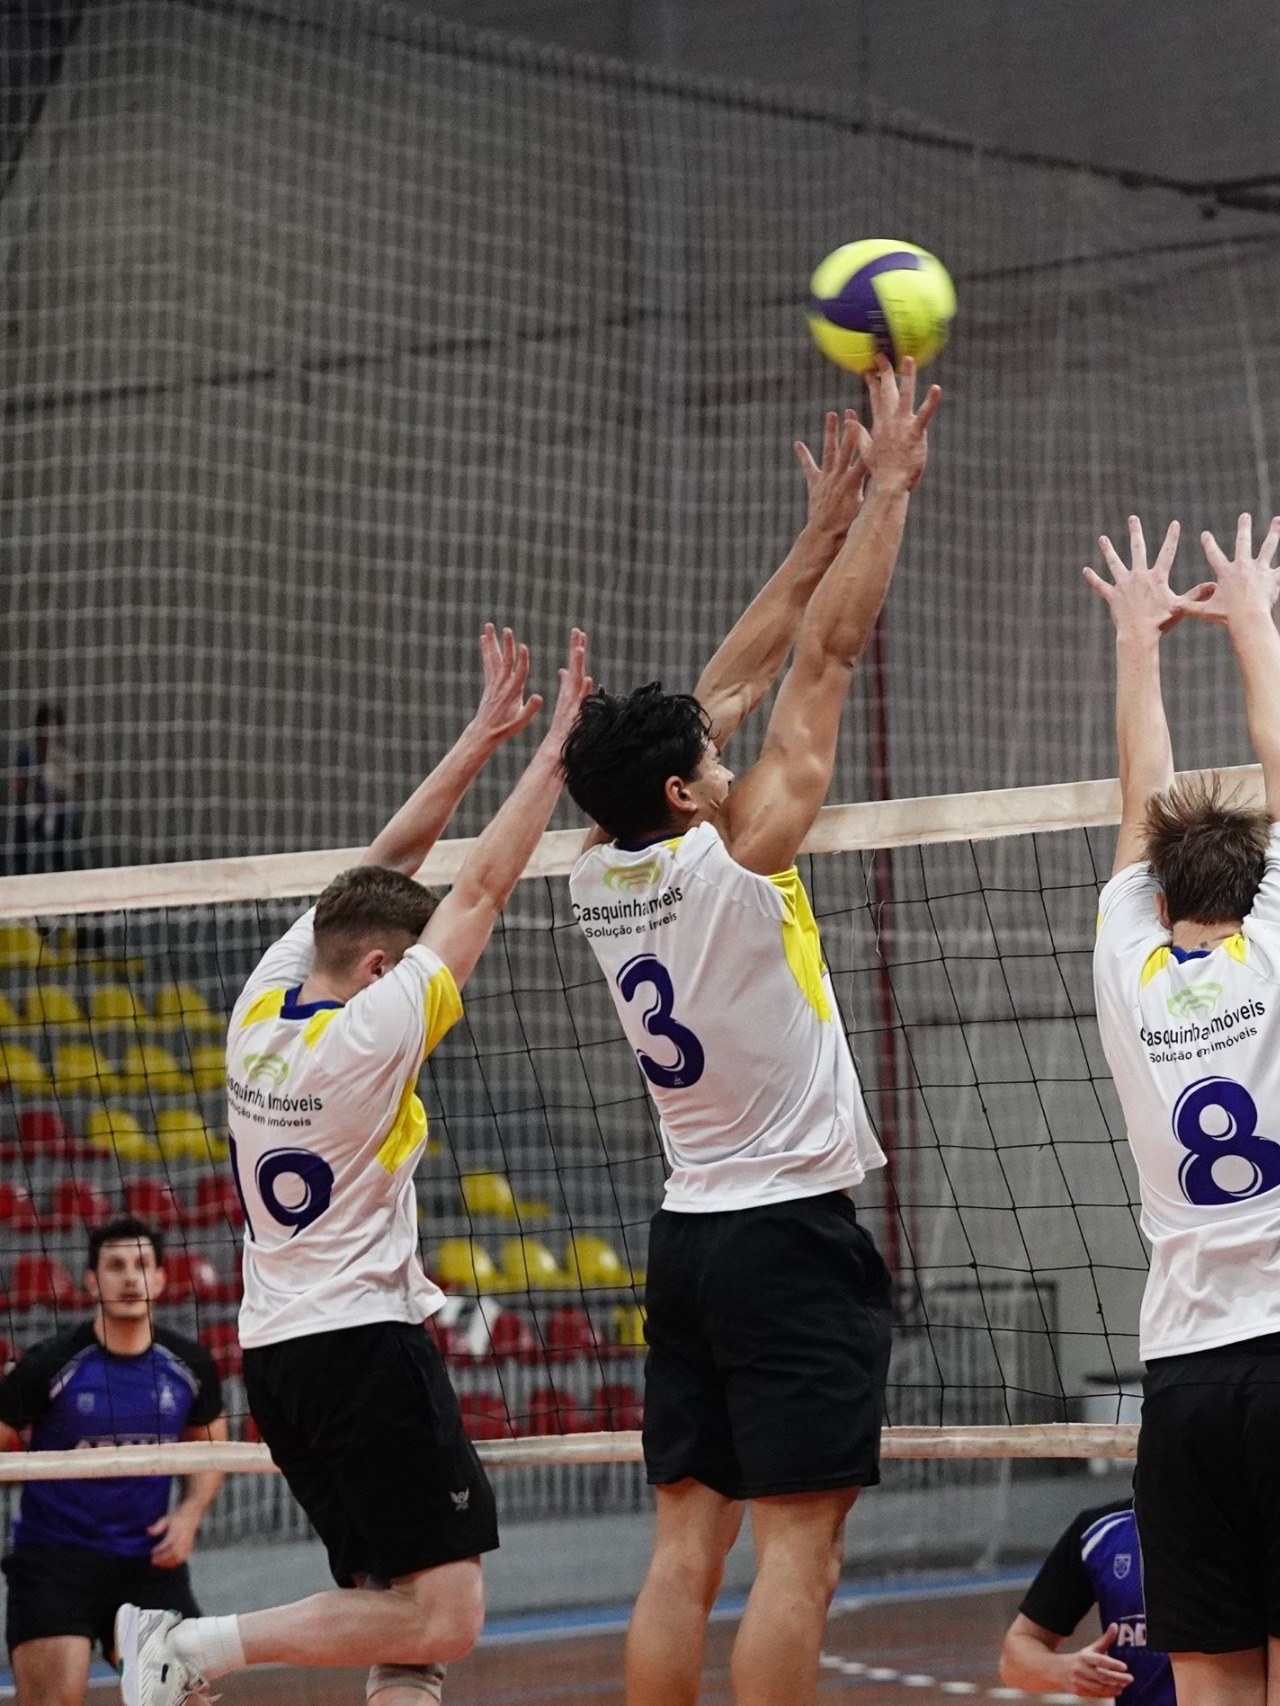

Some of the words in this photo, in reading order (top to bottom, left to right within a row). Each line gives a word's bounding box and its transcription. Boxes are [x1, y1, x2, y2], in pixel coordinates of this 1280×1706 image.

[616, 953, 705, 1089] 3
[1210, 1026, 1258, 1052] imóveis
[268, 1093, 323, 1112] Imóveis
[252, 1113, 266, 1125] em
[267, 1116, 312, 1128] imóveis
